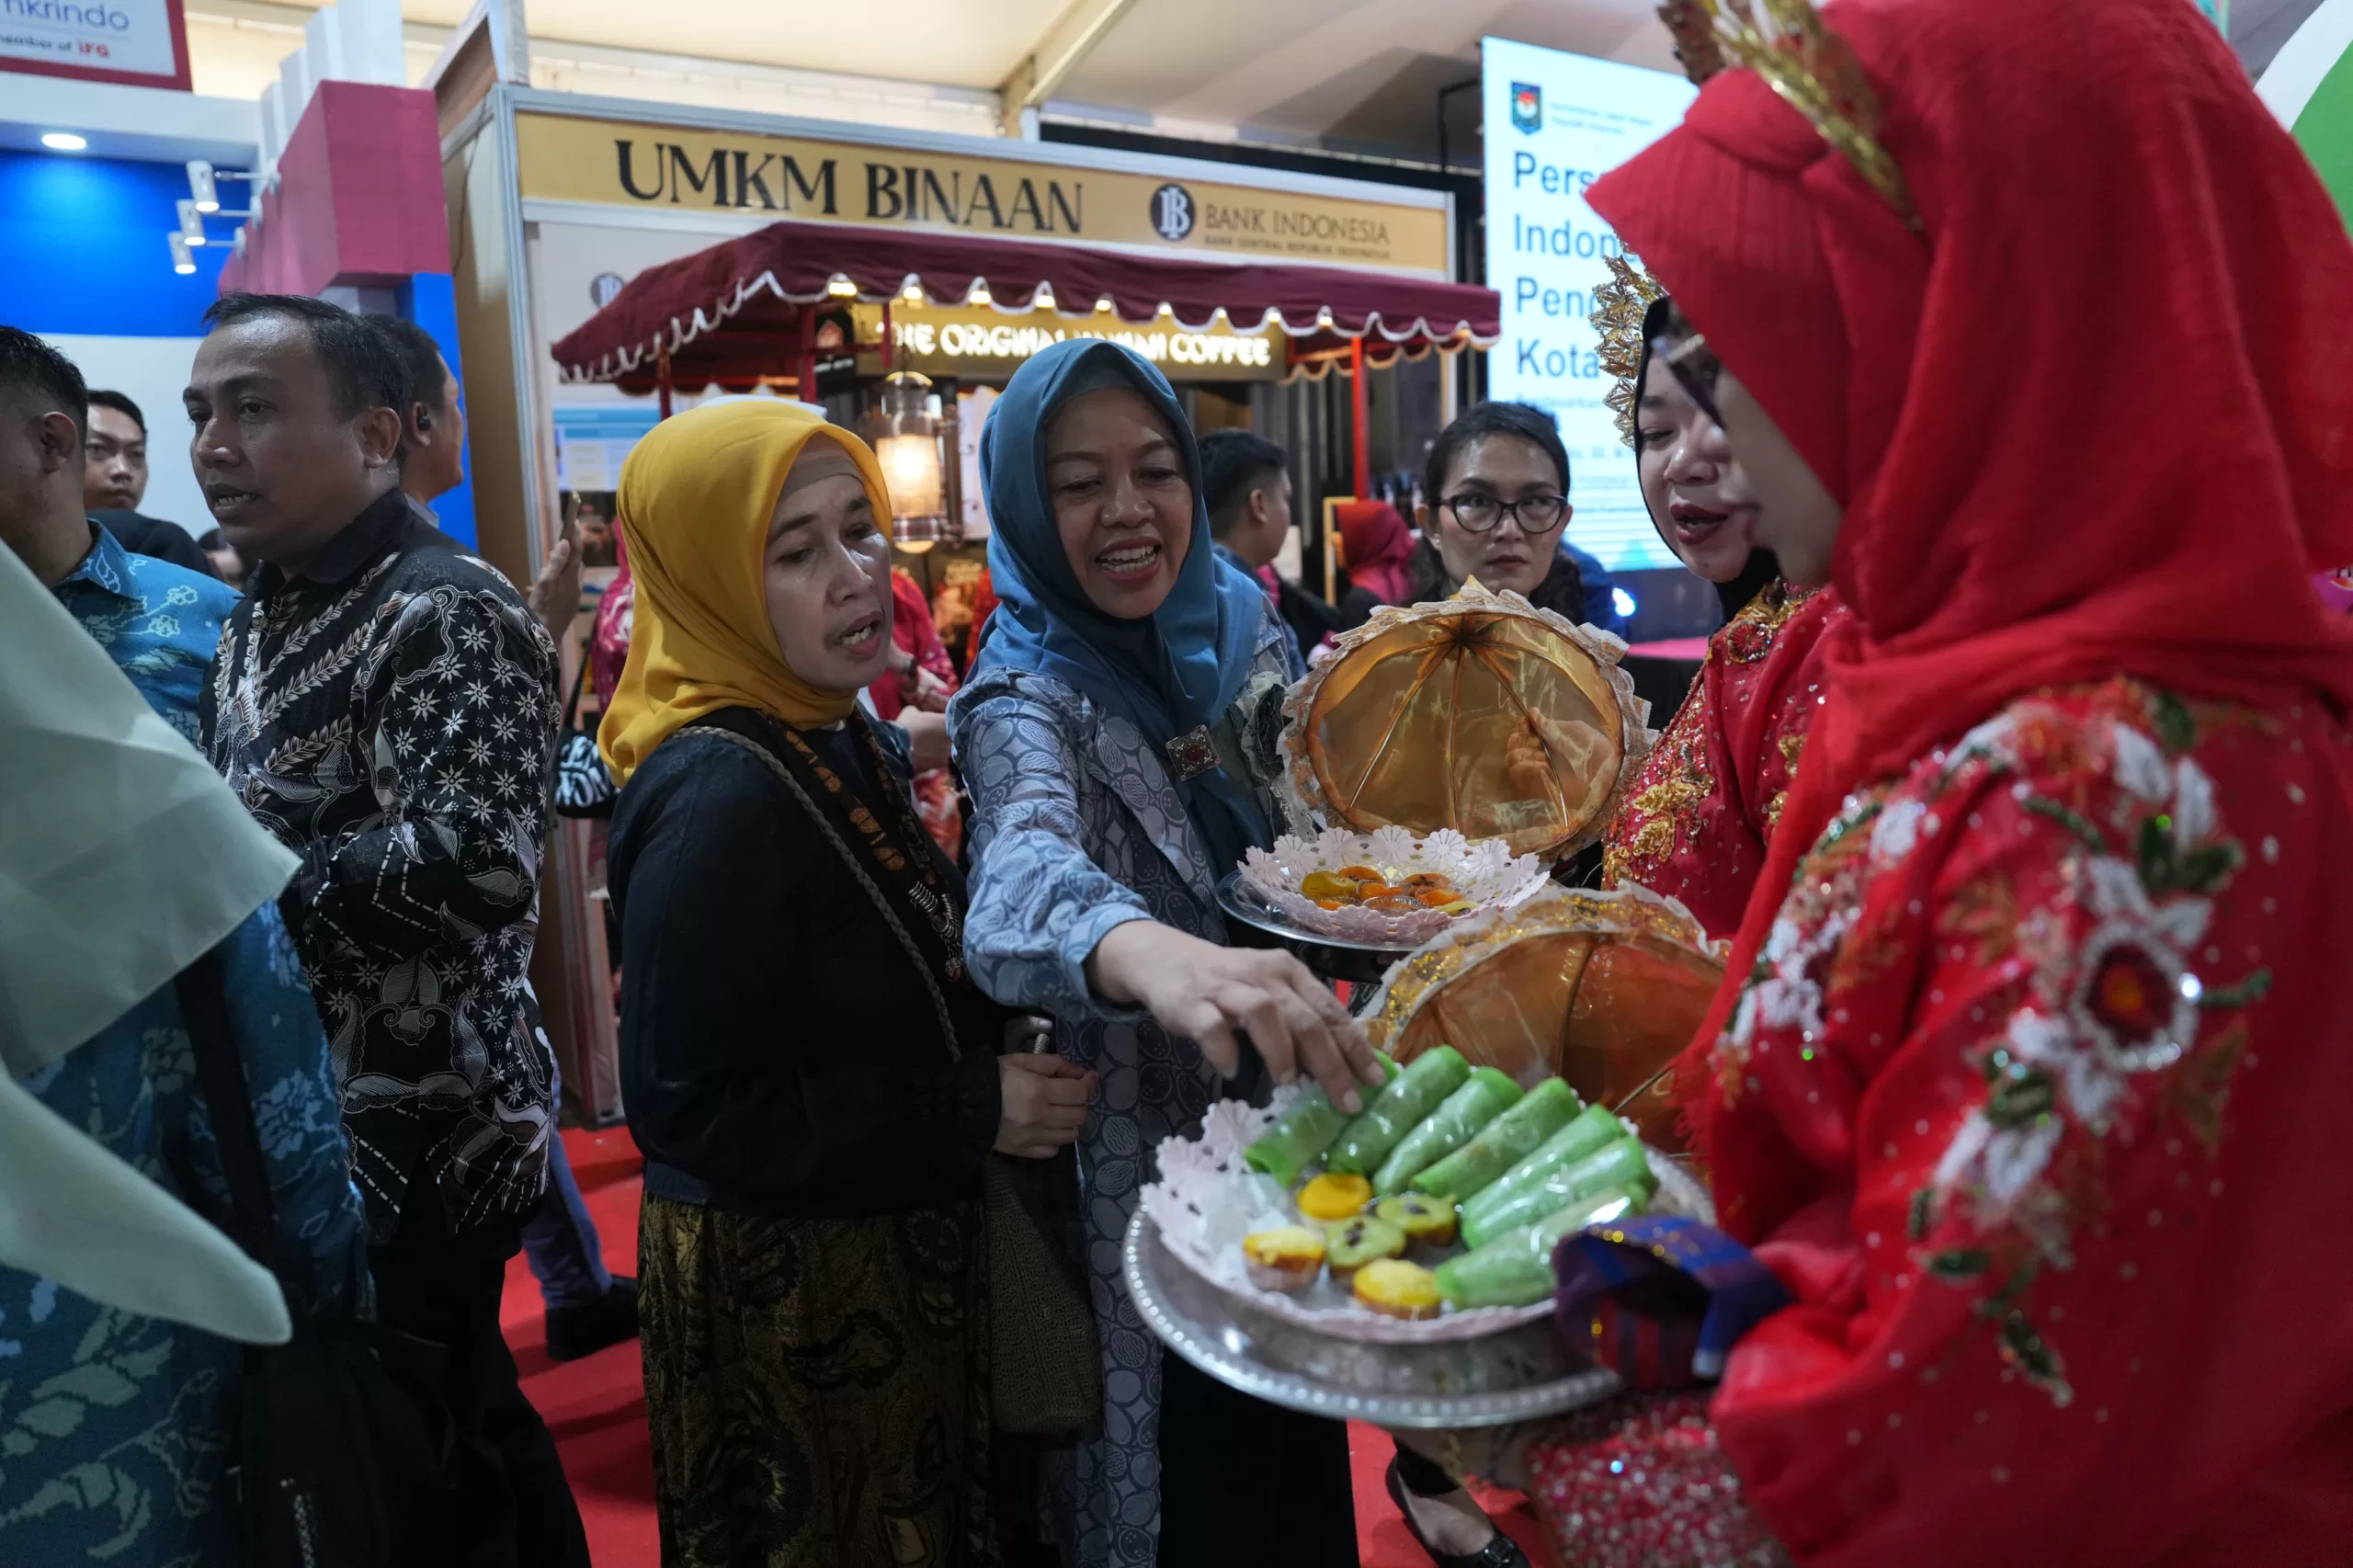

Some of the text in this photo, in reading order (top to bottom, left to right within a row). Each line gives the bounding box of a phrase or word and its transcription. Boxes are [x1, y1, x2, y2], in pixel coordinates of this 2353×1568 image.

[614, 139, 1083, 233] UMKM BINAAN
[1204, 203, 1391, 244] BANK INDONESIA
[1514, 212, 1640, 263] Indon
[1516, 276, 1597, 322] Pen
[1168, 333, 1272, 367] COFFEE
[1517, 337, 1600, 379] Kota
